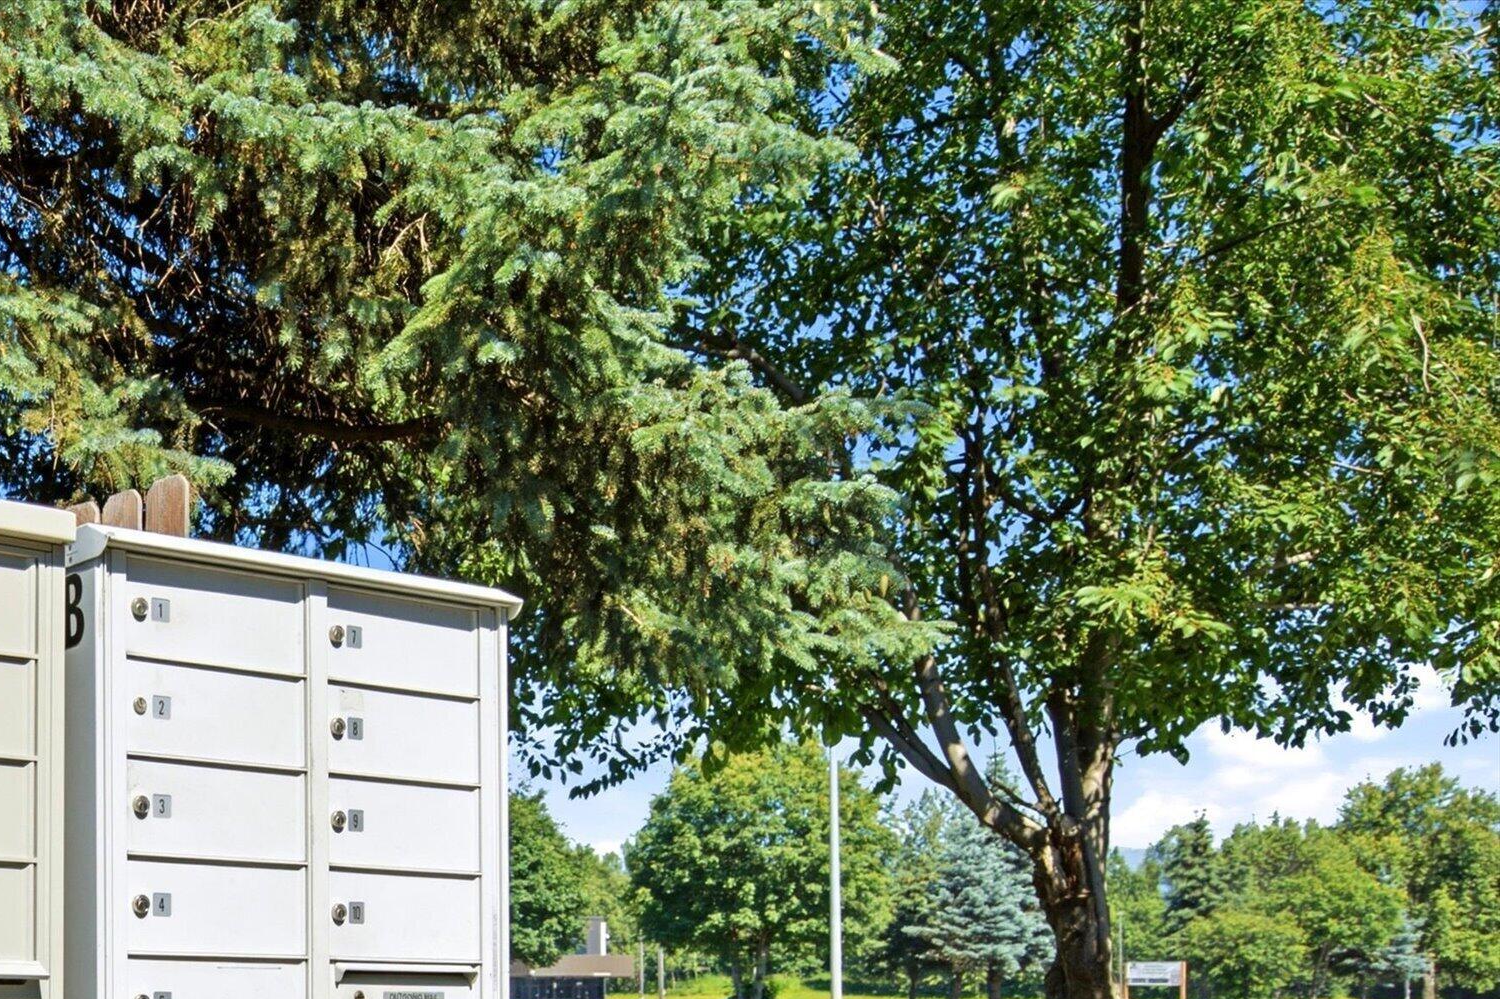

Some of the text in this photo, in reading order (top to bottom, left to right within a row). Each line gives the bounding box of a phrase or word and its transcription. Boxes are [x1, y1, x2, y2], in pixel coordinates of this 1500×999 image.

[65, 573, 85, 650] B
[158, 603, 163, 618] 1
[351, 630, 357, 644] 7
[158, 700, 165, 715] 2
[352, 722, 359, 735] 8
[159, 799, 166, 814] 3
[352, 814, 359, 828] 9
[158, 898, 165, 911] 4
[352, 906, 361, 920] 10
